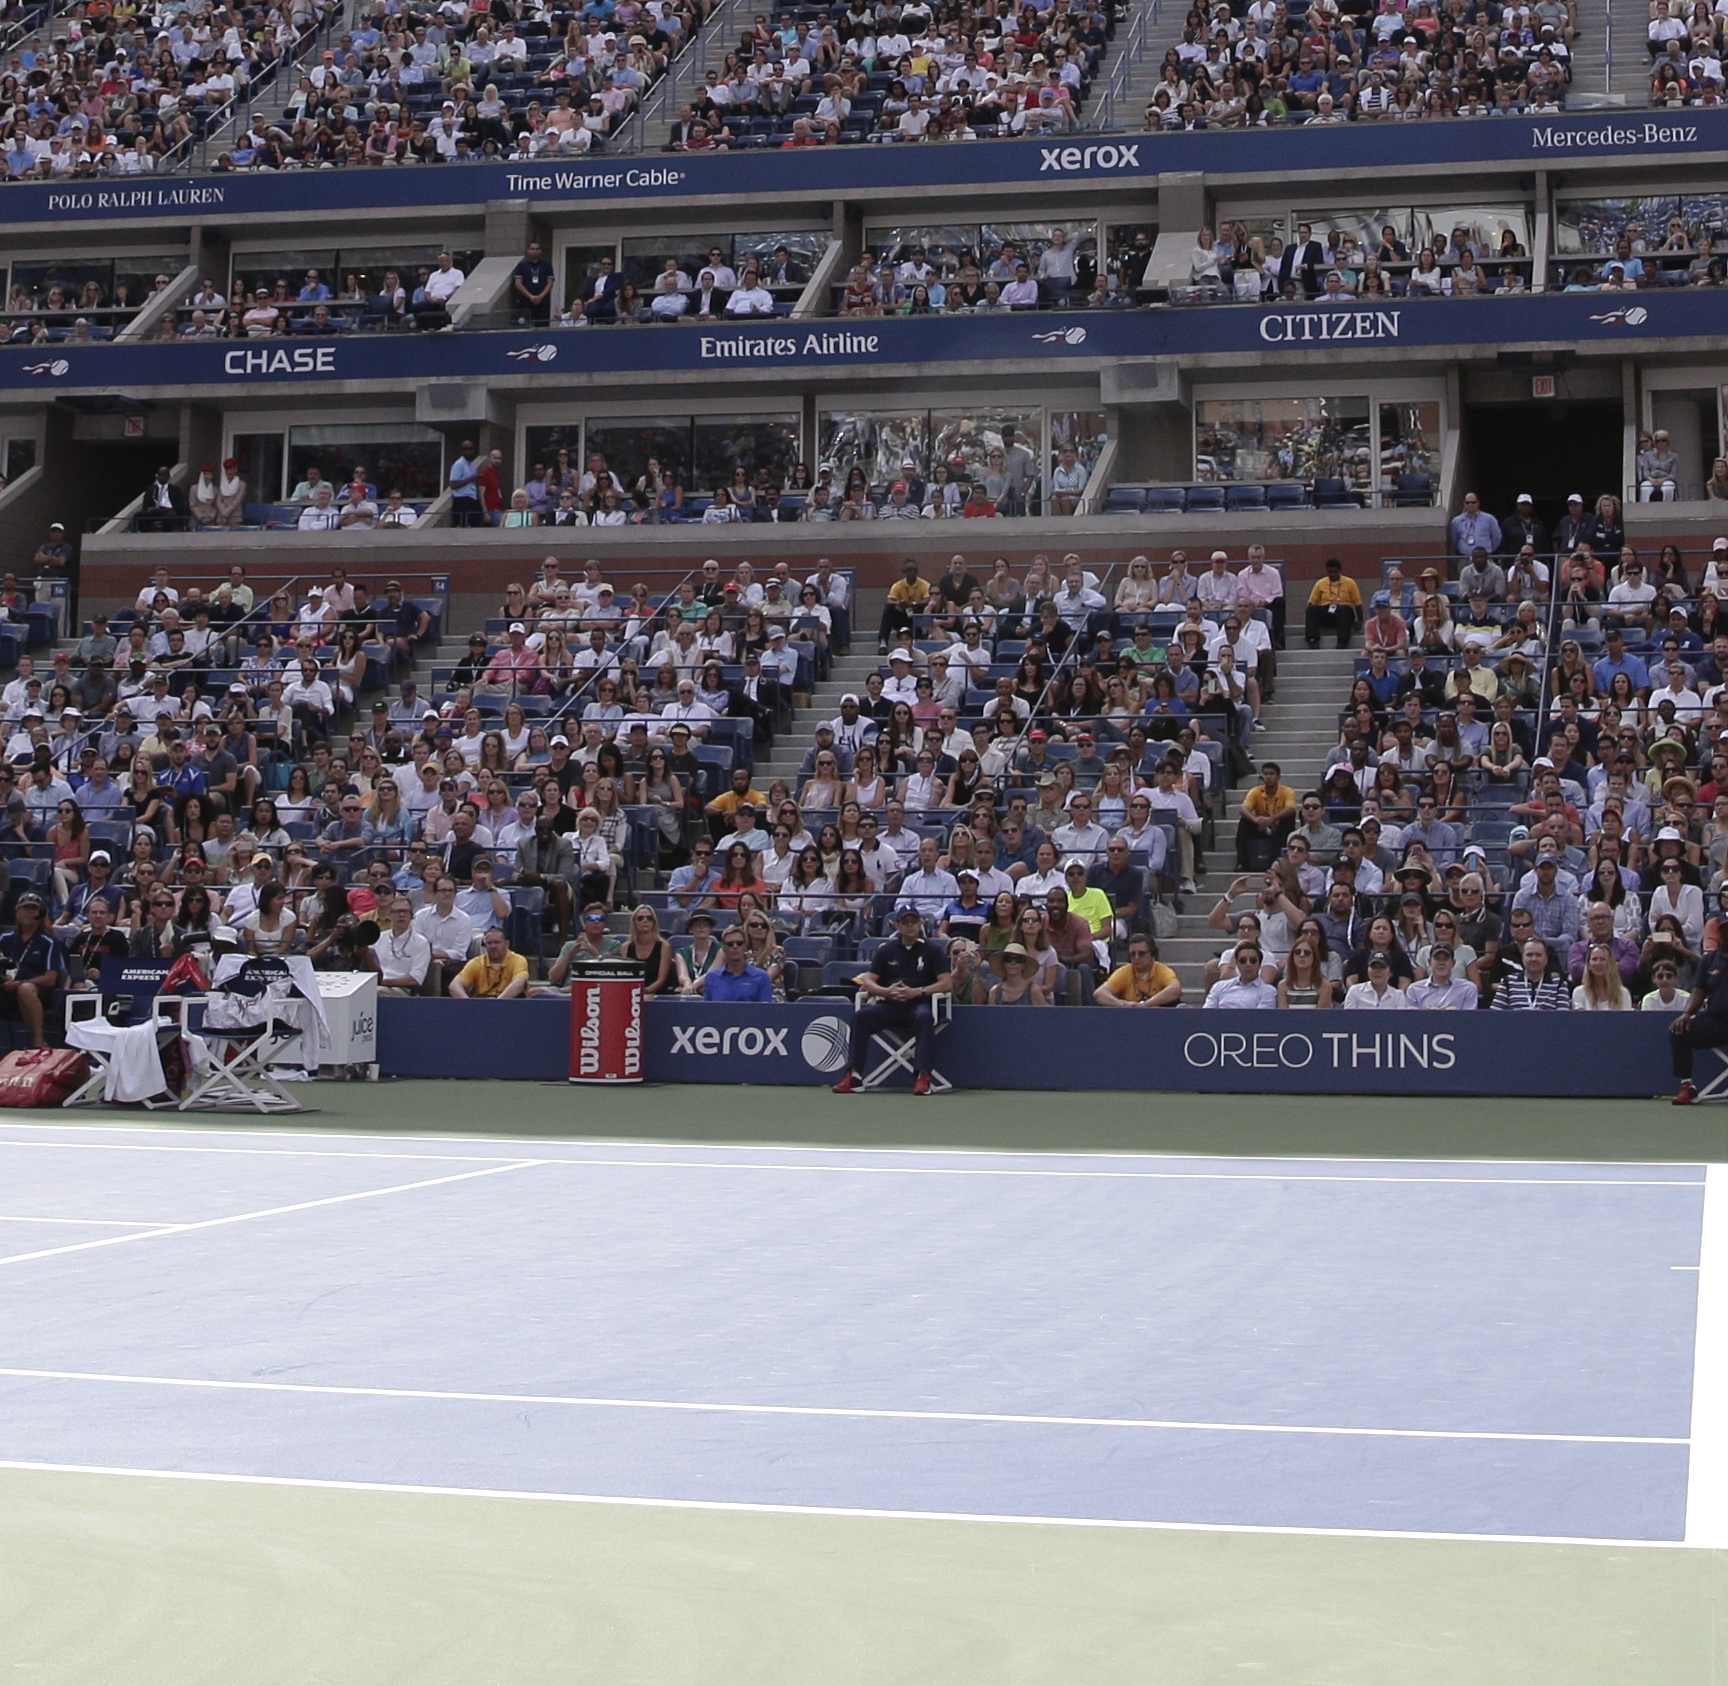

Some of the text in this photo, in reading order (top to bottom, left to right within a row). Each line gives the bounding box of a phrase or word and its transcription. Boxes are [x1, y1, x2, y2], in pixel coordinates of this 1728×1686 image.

[1531, 123, 1697, 148] Mercedes-Benz
[1040, 145, 1139, 171] xerox
[506, 168, 679, 192] Time Warner Cable
[48, 187, 225, 211] POLO RALPH LAUREN
[1259, 311, 1401, 342] CITIZEN
[699, 330, 879, 360] Emirates Airline
[224, 347, 336, 375] CHASE
[580, 984, 600, 1074] Wilson
[625, 986, 641, 1075] Wilson
[671, 1026, 788, 1055] xerox
[1183, 1032, 1456, 1069] OREO THINS
